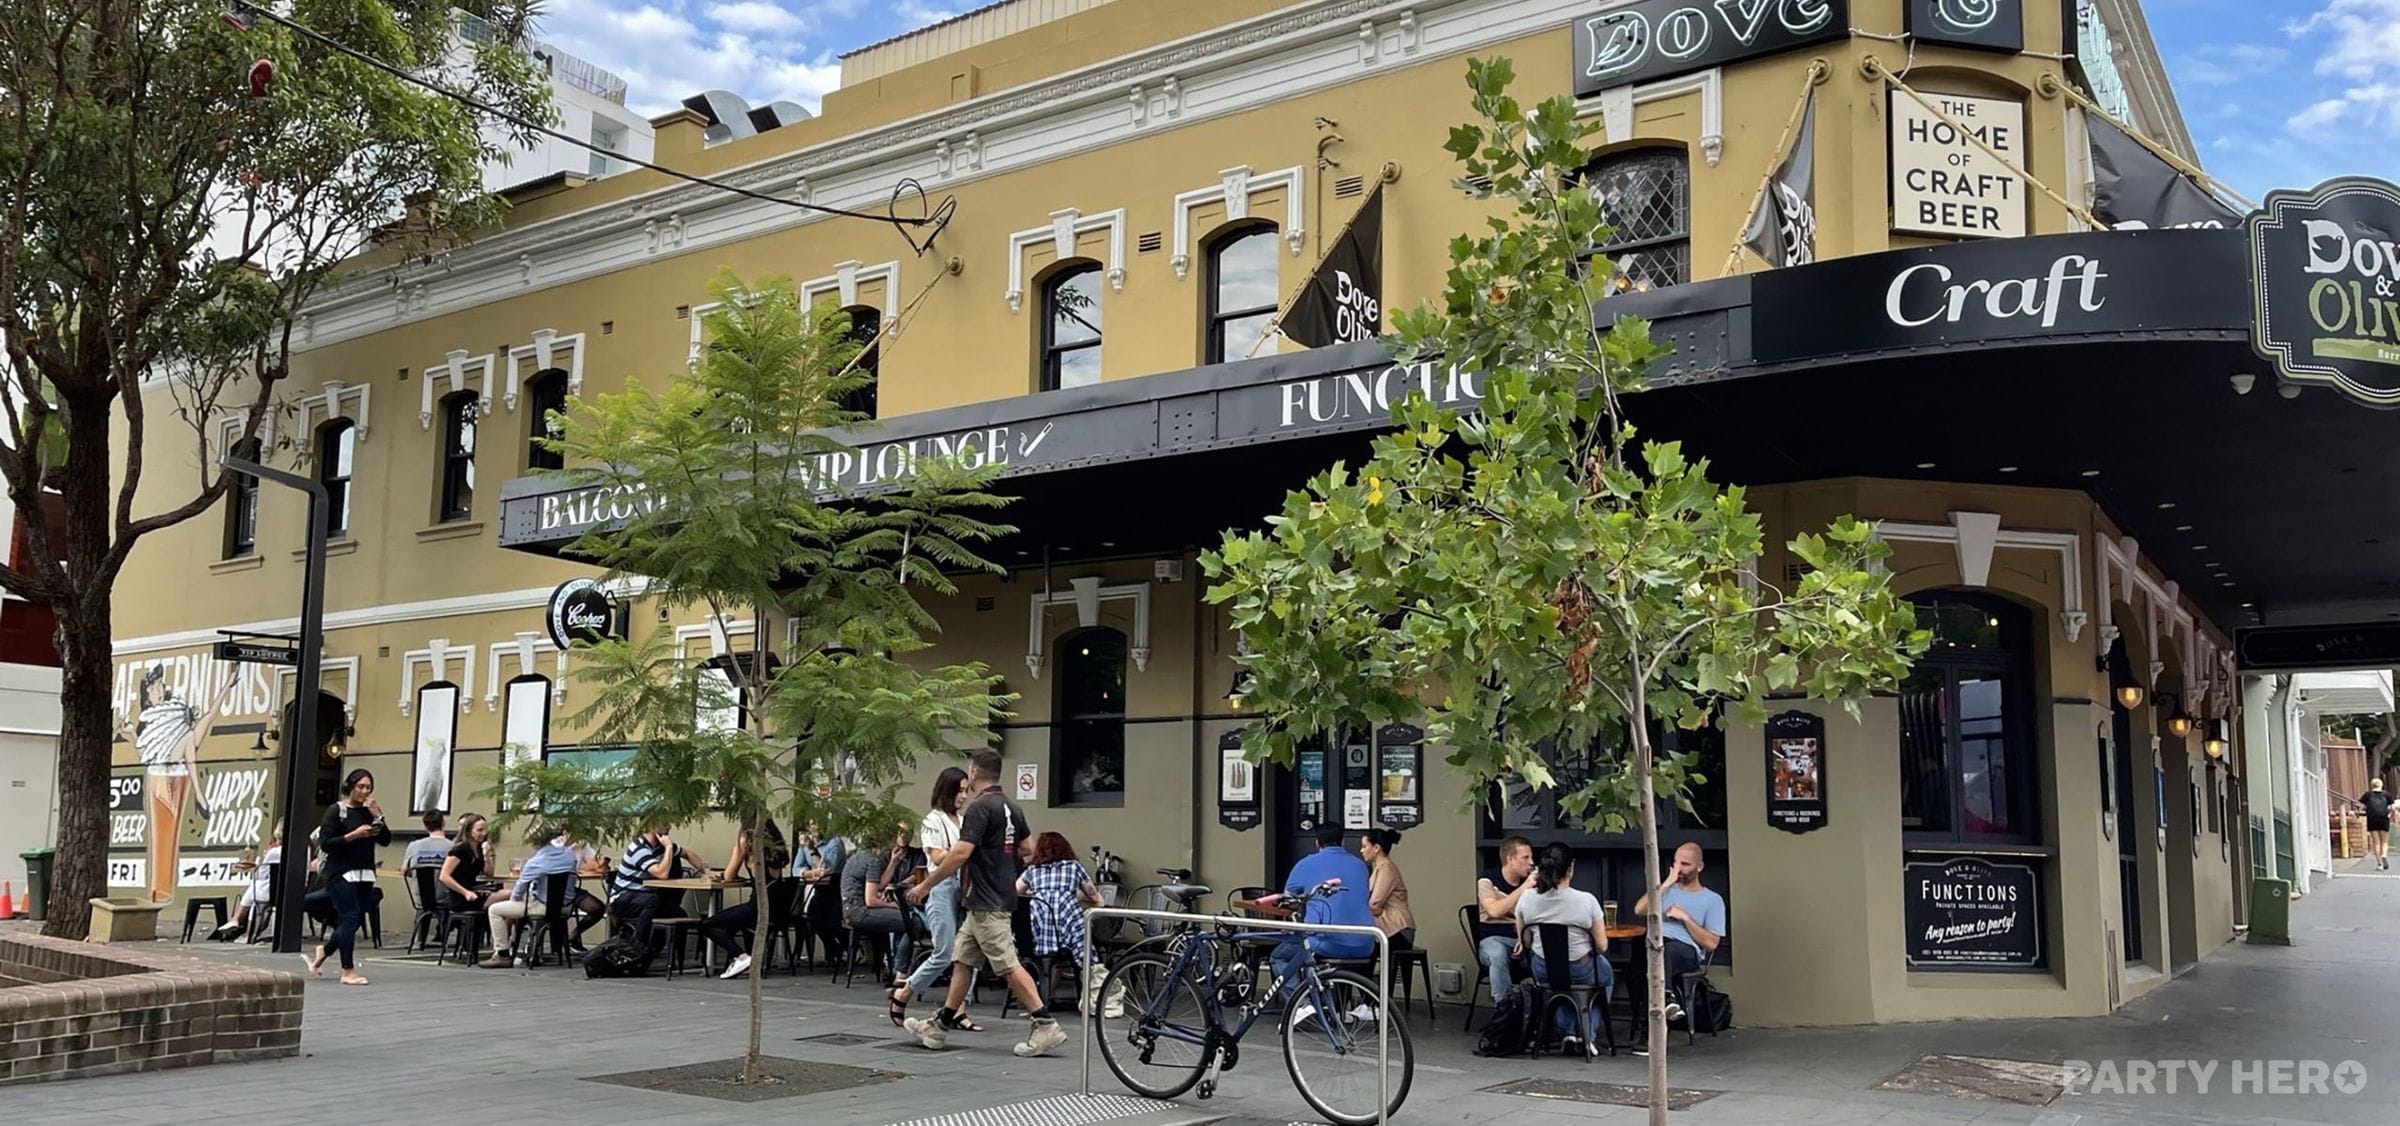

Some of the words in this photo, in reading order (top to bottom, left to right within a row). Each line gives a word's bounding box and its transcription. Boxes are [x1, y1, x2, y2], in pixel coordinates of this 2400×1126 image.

[1940, 101, 1976, 117] THE
[1908, 118, 2009, 151] HOME
[1948, 153, 1971, 167] OF
[1906, 168, 2013, 200] CRAFT
[1919, 200, 2001, 231] BEER
[1886, 254, 2108, 328] Craft
[2375, 275, 2394, 297] &
[799, 451, 851, 491] VIP
[857, 427, 1009, 486] LOUNGE
[205, 768, 268, 812] HAPPY
[112, 814, 147, 844] BEER
[204, 807, 262, 846] HOUR
[111, 863, 137, 880] FRI
[1922, 880, 2017, 901] FUNCTIONS
[1925, 925, 1945, 943] Any
[1945, 922, 1975, 936] reason
[1977, 919, 1986, 931] to
[1987, 911, 2017, 935] party!
